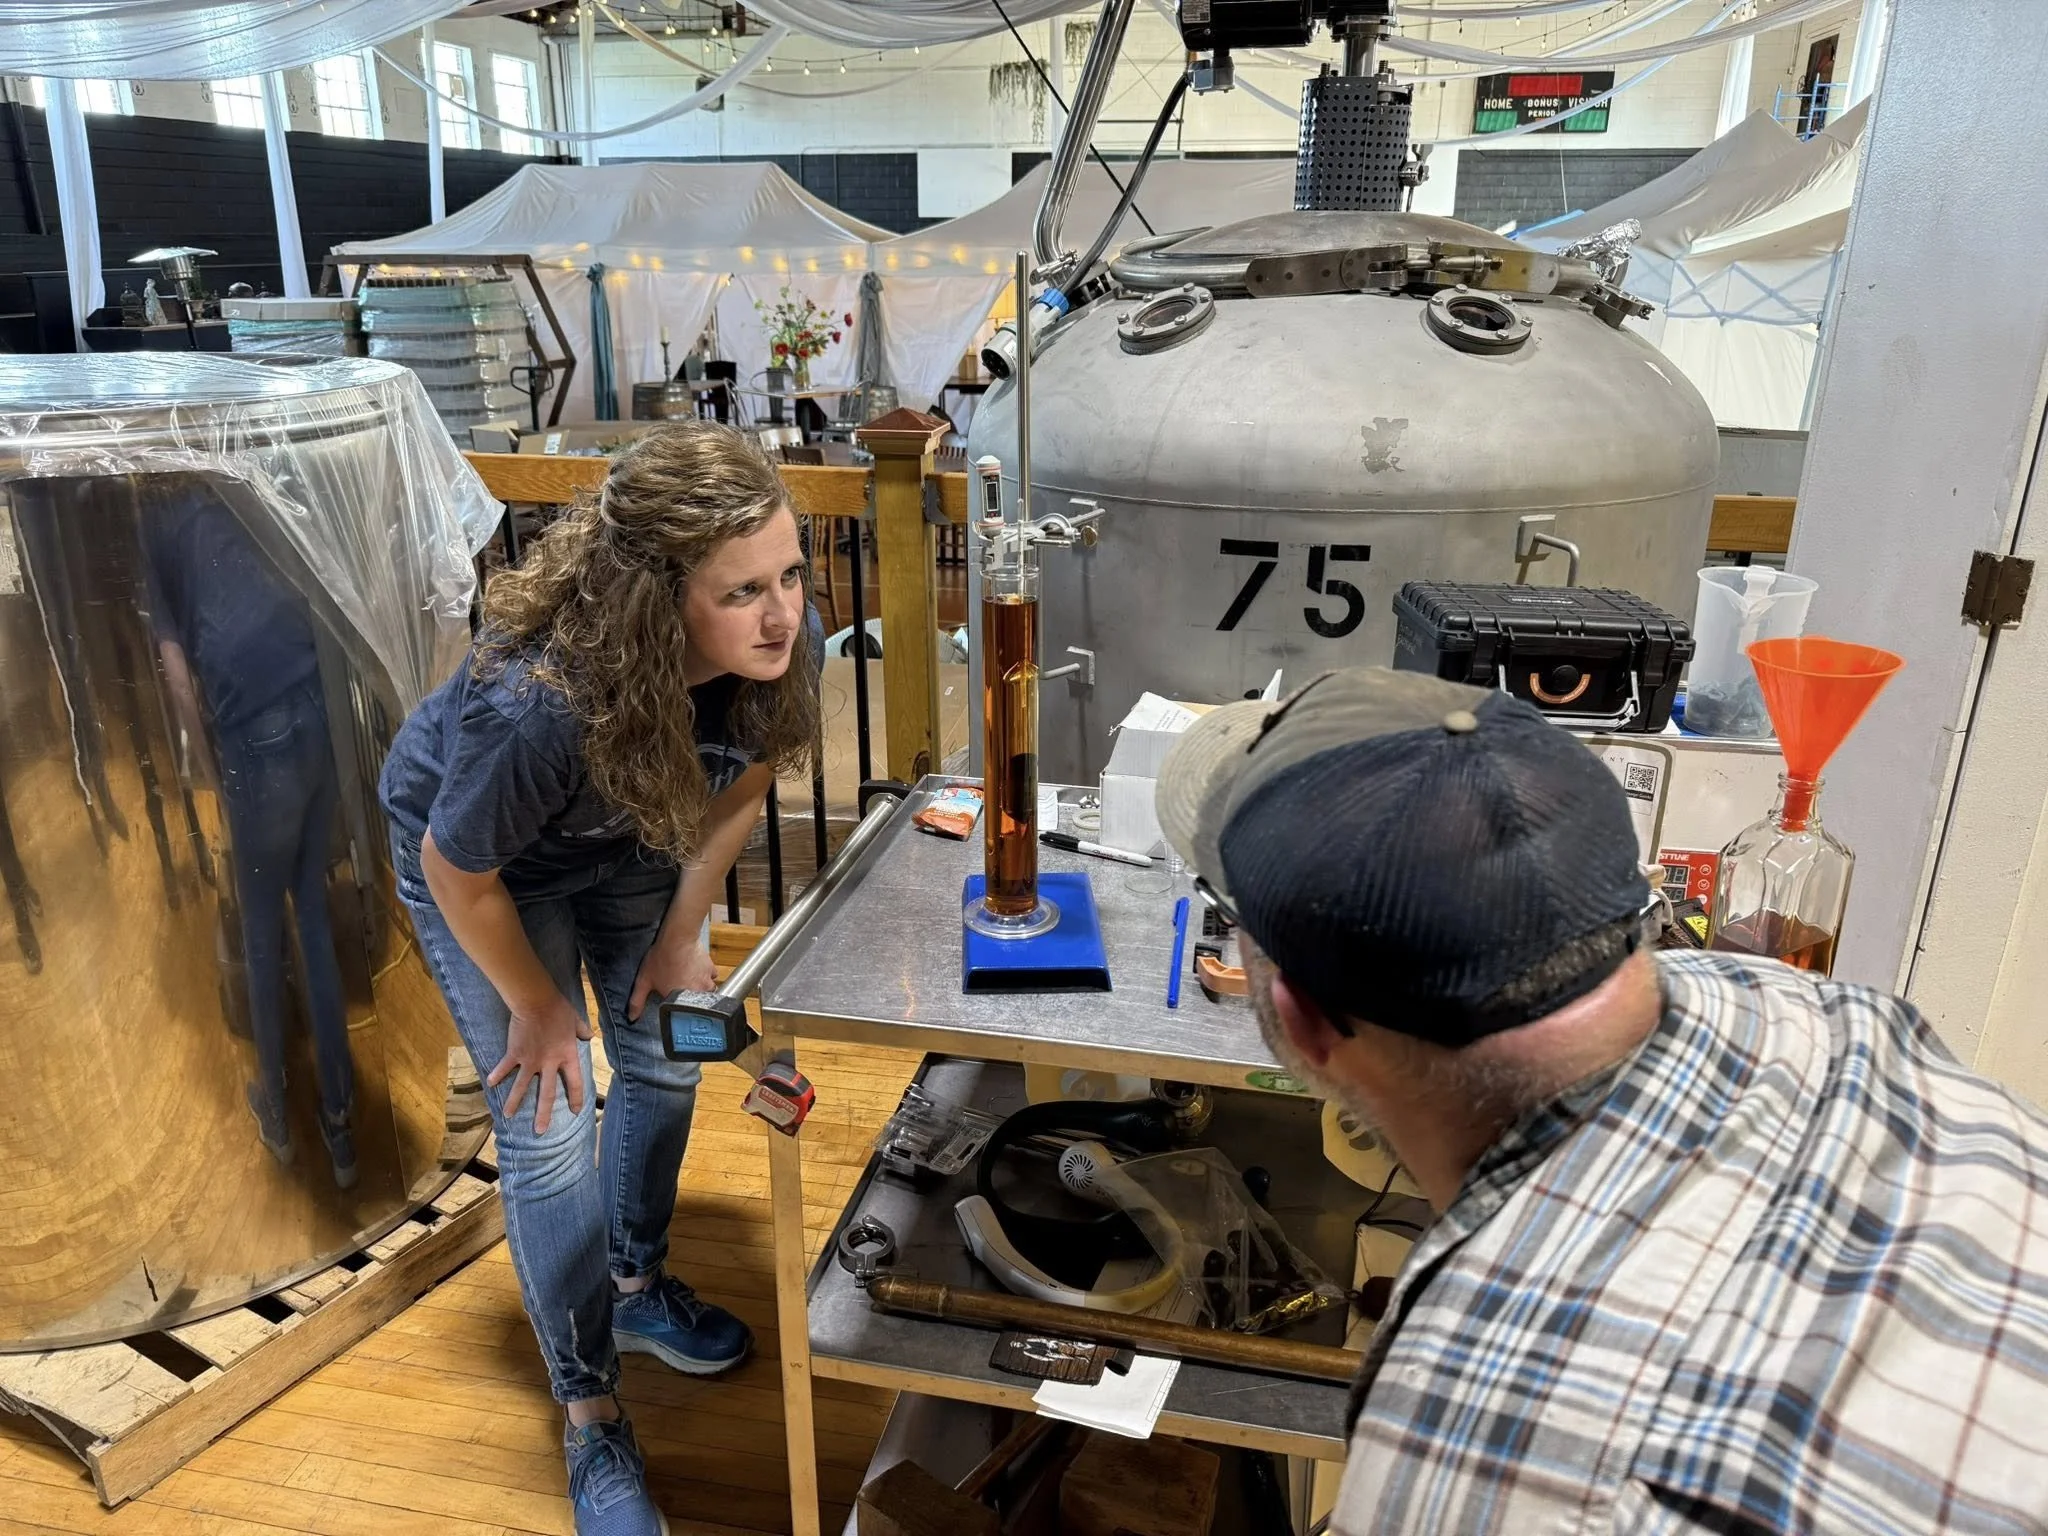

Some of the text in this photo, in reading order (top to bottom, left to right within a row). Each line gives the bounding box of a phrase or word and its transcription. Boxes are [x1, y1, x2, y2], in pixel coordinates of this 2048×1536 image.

[1484, 98, 1513, 110] HOME
[1527, 98, 1559, 108] BONUS
[1216, 538, 1371, 638] 75
